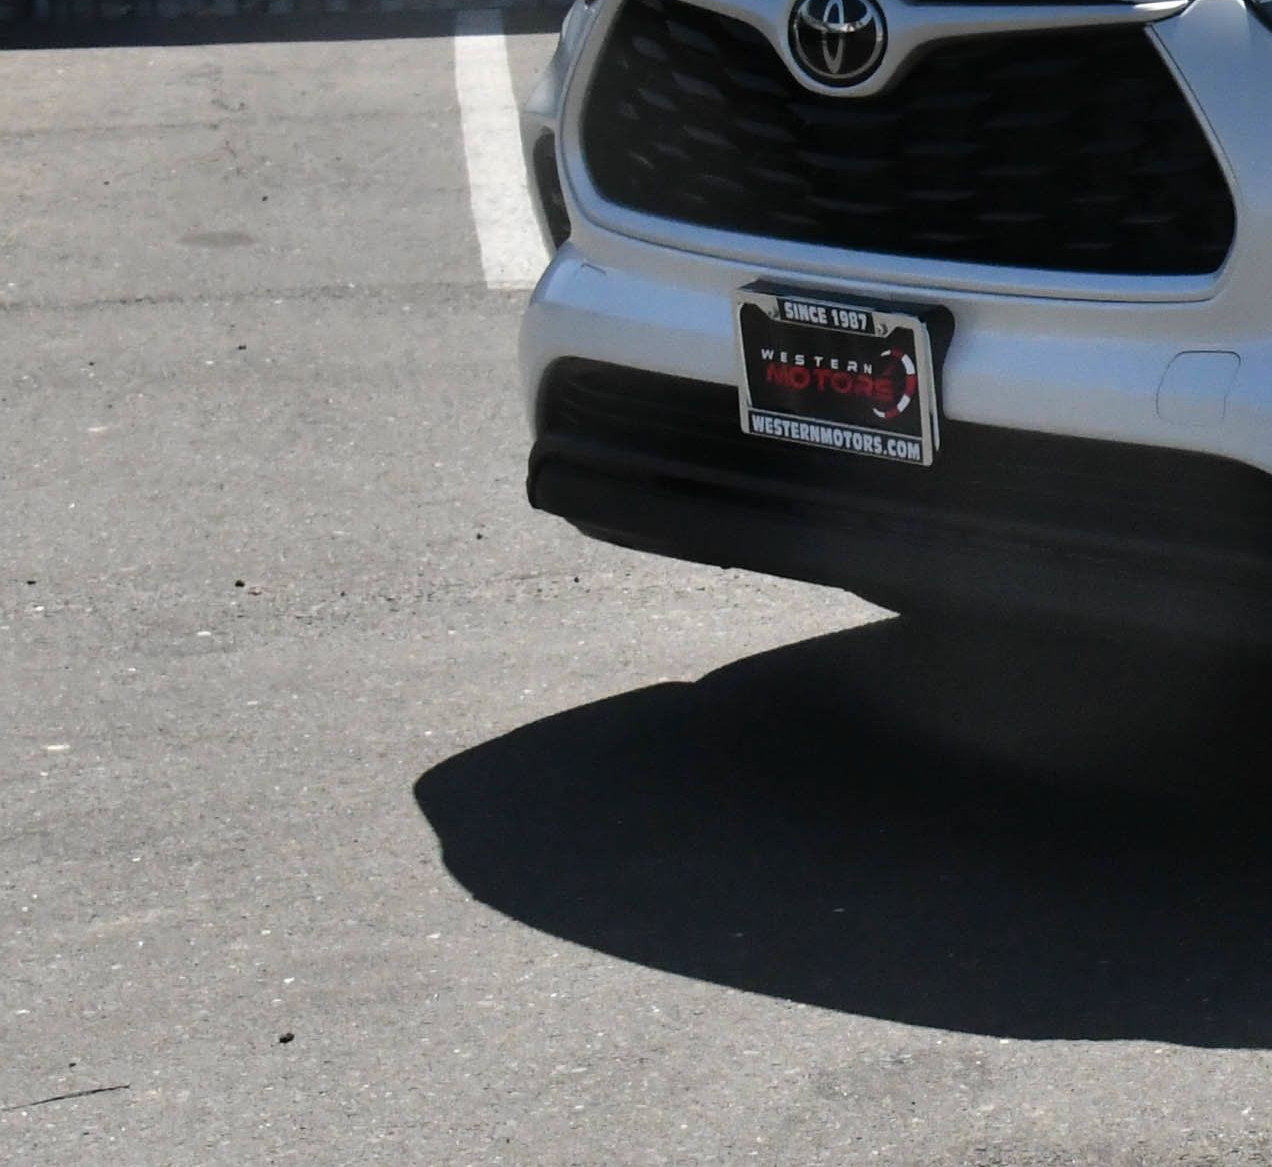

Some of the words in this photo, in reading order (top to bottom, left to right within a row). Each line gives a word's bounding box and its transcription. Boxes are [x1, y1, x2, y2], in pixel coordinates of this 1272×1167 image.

[784, 301, 828, 325] SINCE
[831, 309, 868, 330] 1987
[761, 348, 873, 375] WESTERN
[766, 362, 895, 402] MOTORS
[751, 415, 921, 461] WESTERNMOTORS.COM
